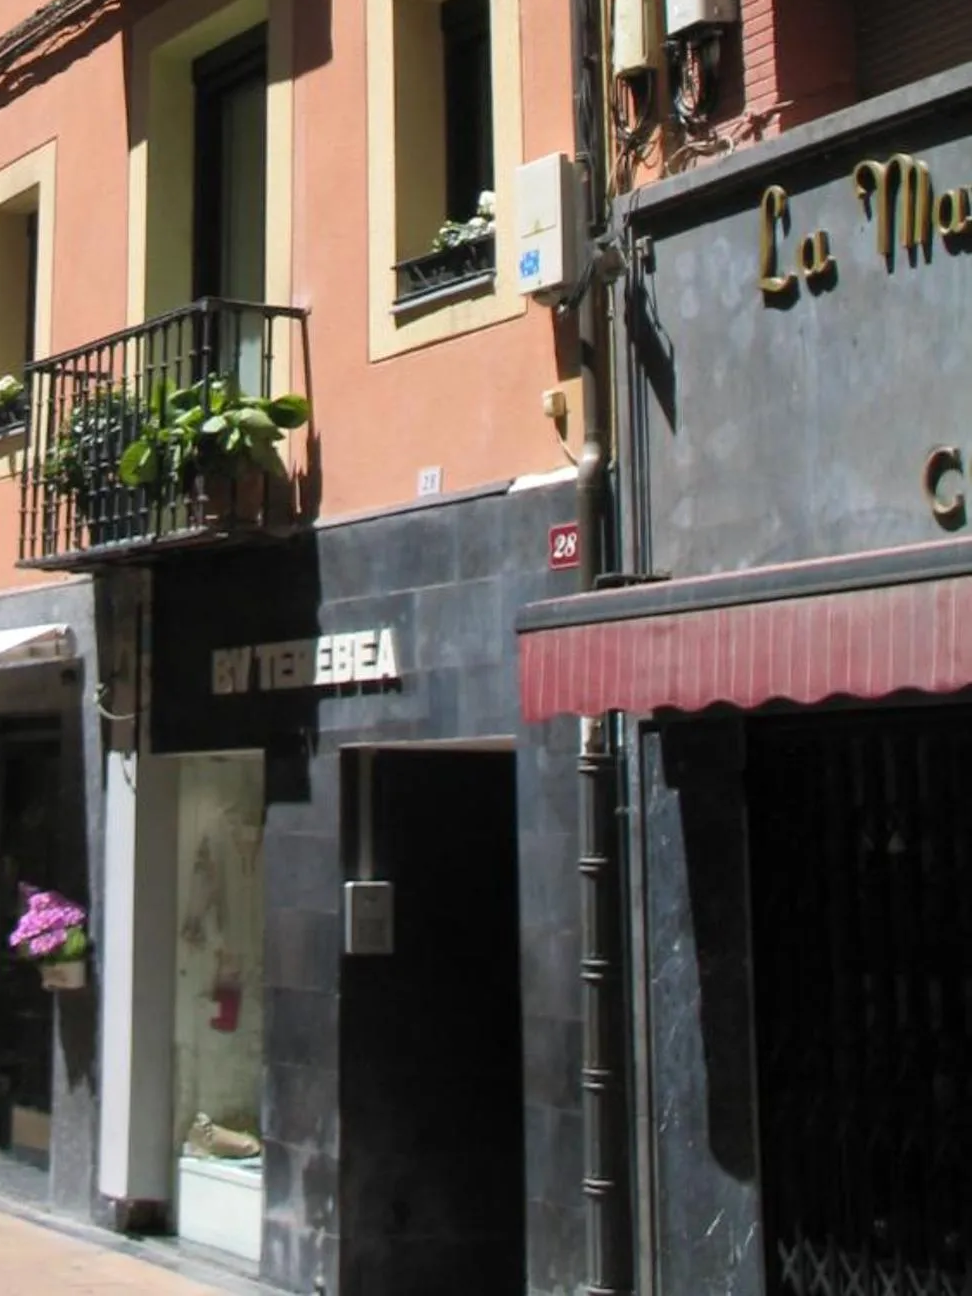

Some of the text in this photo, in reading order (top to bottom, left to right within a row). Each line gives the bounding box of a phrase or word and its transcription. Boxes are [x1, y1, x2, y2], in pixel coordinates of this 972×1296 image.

[759, 152, 972, 292] La Ma
[553, 532, 577, 558] 28
